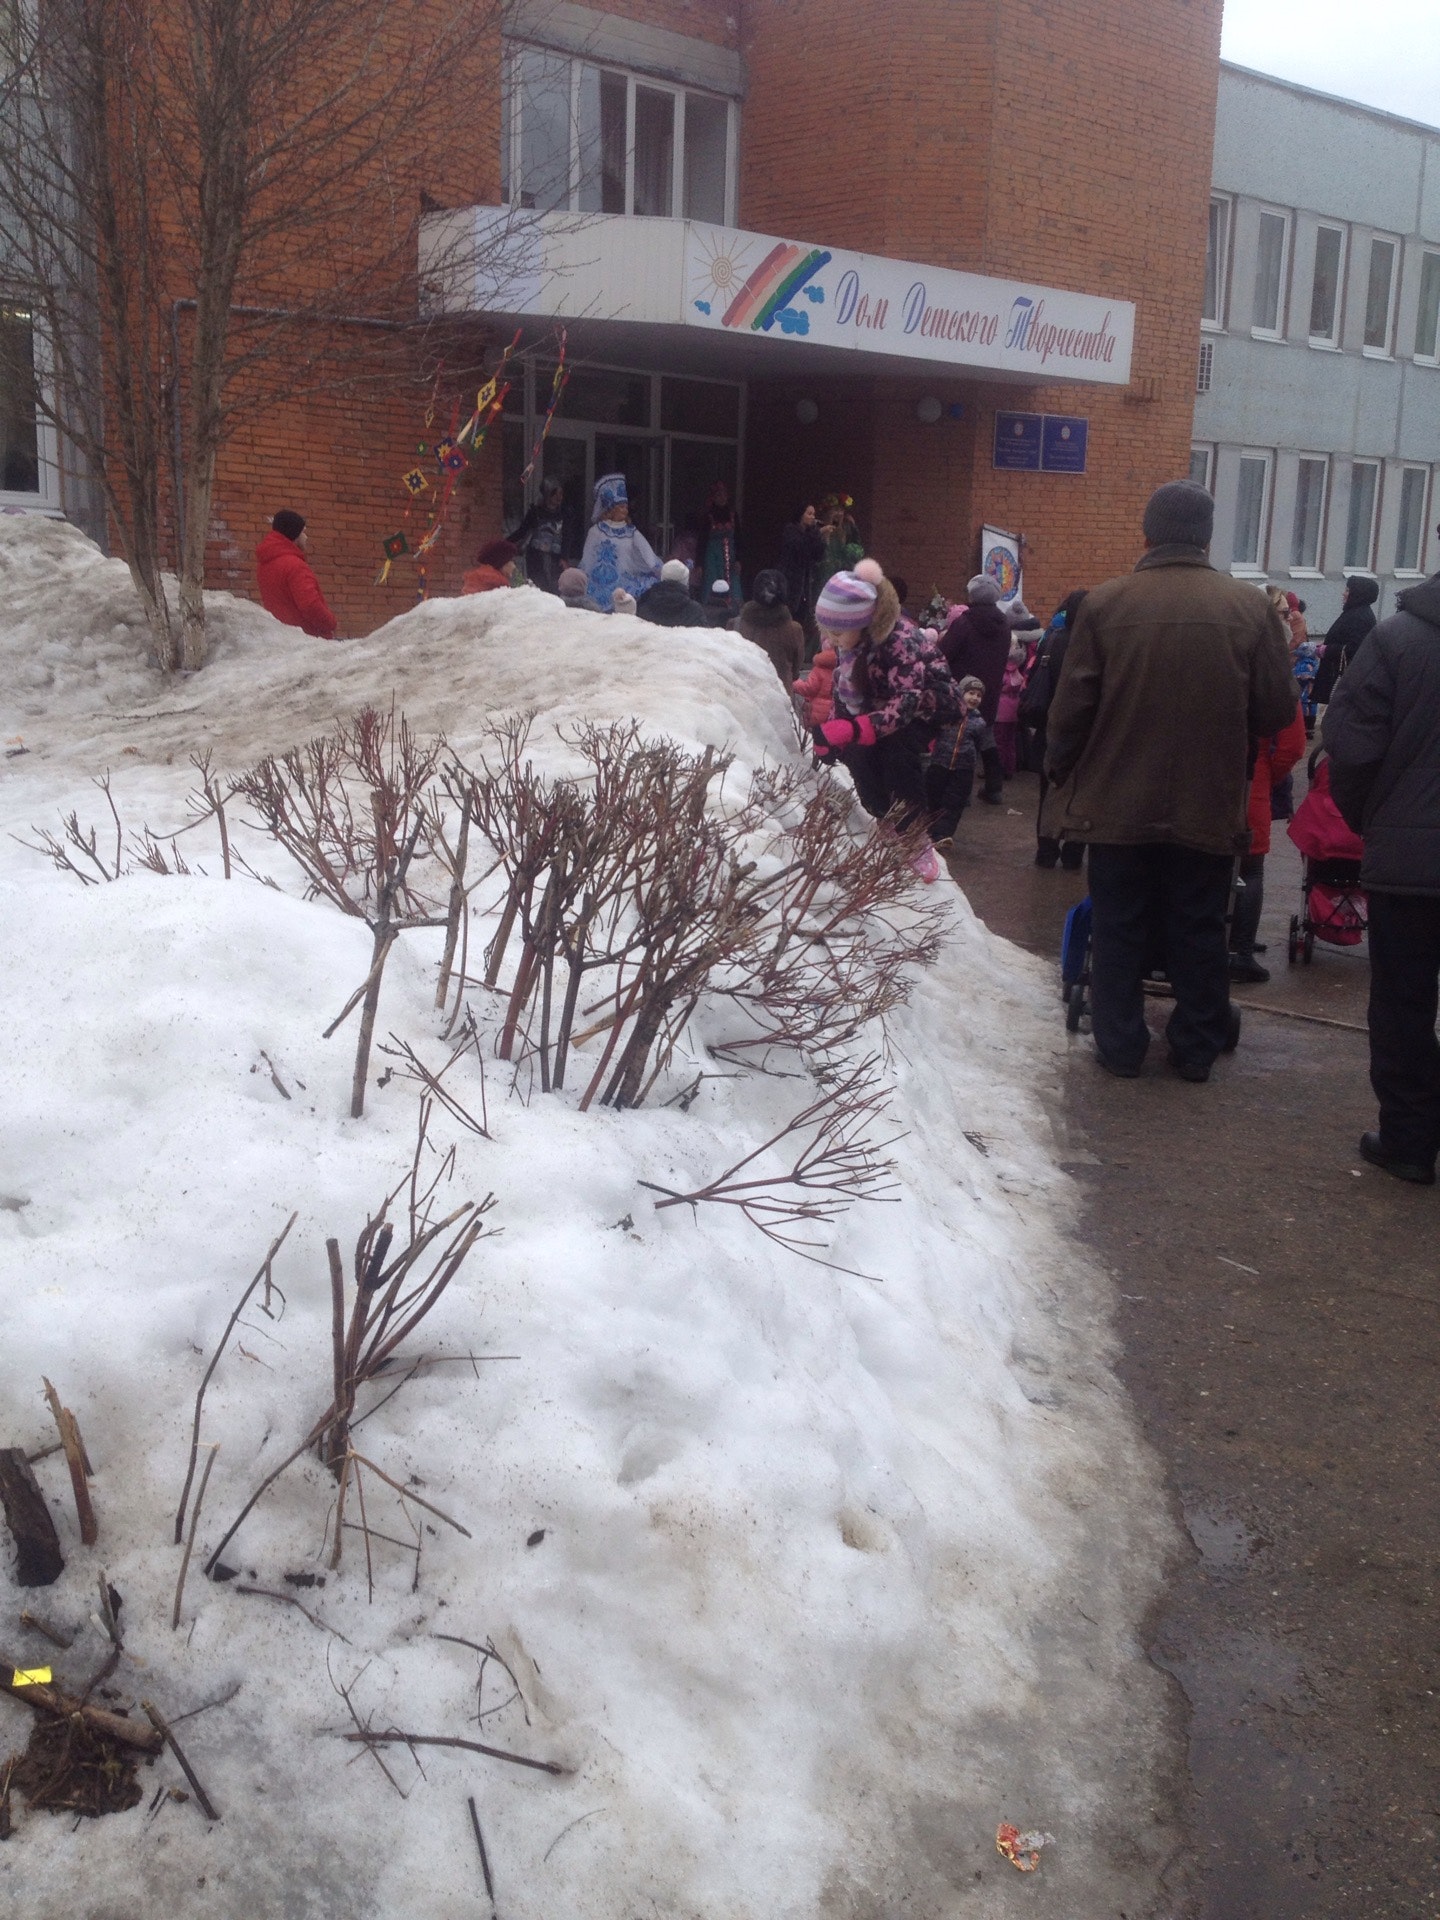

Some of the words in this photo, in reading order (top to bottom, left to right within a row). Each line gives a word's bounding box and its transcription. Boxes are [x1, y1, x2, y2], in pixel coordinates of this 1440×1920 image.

[834, 270, 889, 330] Дом
[901, 281, 999, 346] Детского
[1005, 296, 1117, 365] Творчества
